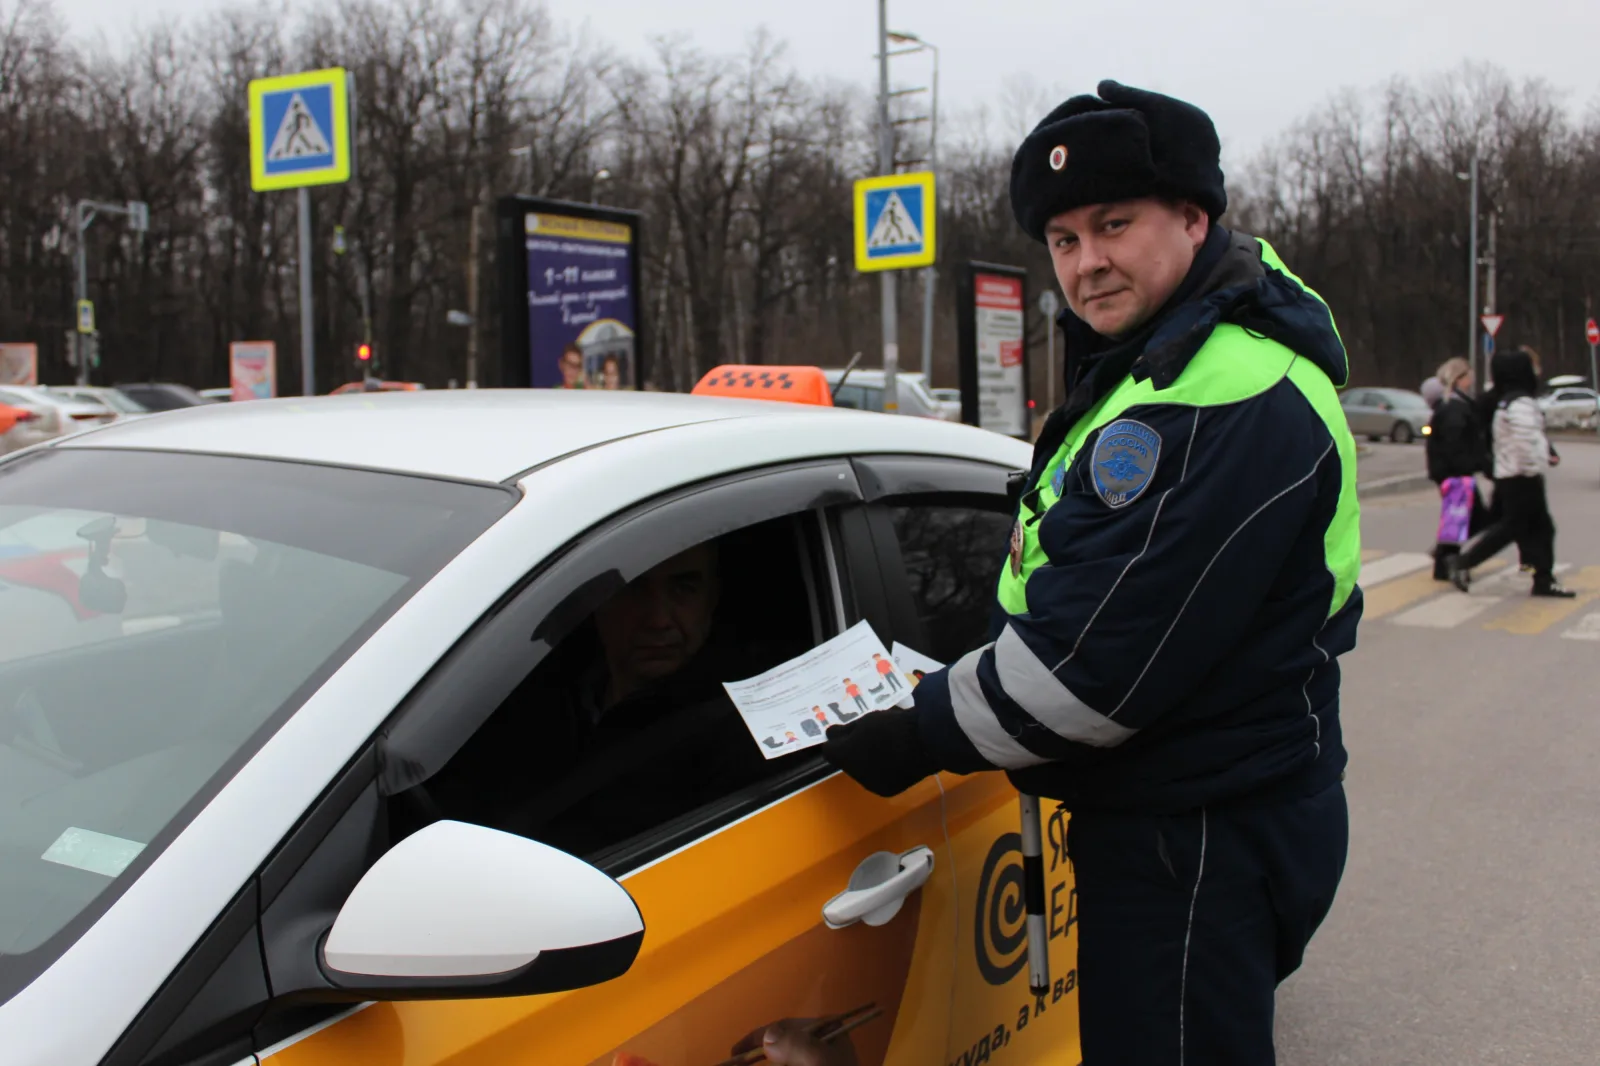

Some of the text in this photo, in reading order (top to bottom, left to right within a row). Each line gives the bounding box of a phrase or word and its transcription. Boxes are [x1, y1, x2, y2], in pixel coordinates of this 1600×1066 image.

[1105, 437, 1148, 457] РОССИЯ
[1104, 488, 1127, 505] МВД
[1048, 809, 1073, 873] Я
[1016, 1004, 1030, 1031] а
[1052, 968, 1078, 1004] ва
